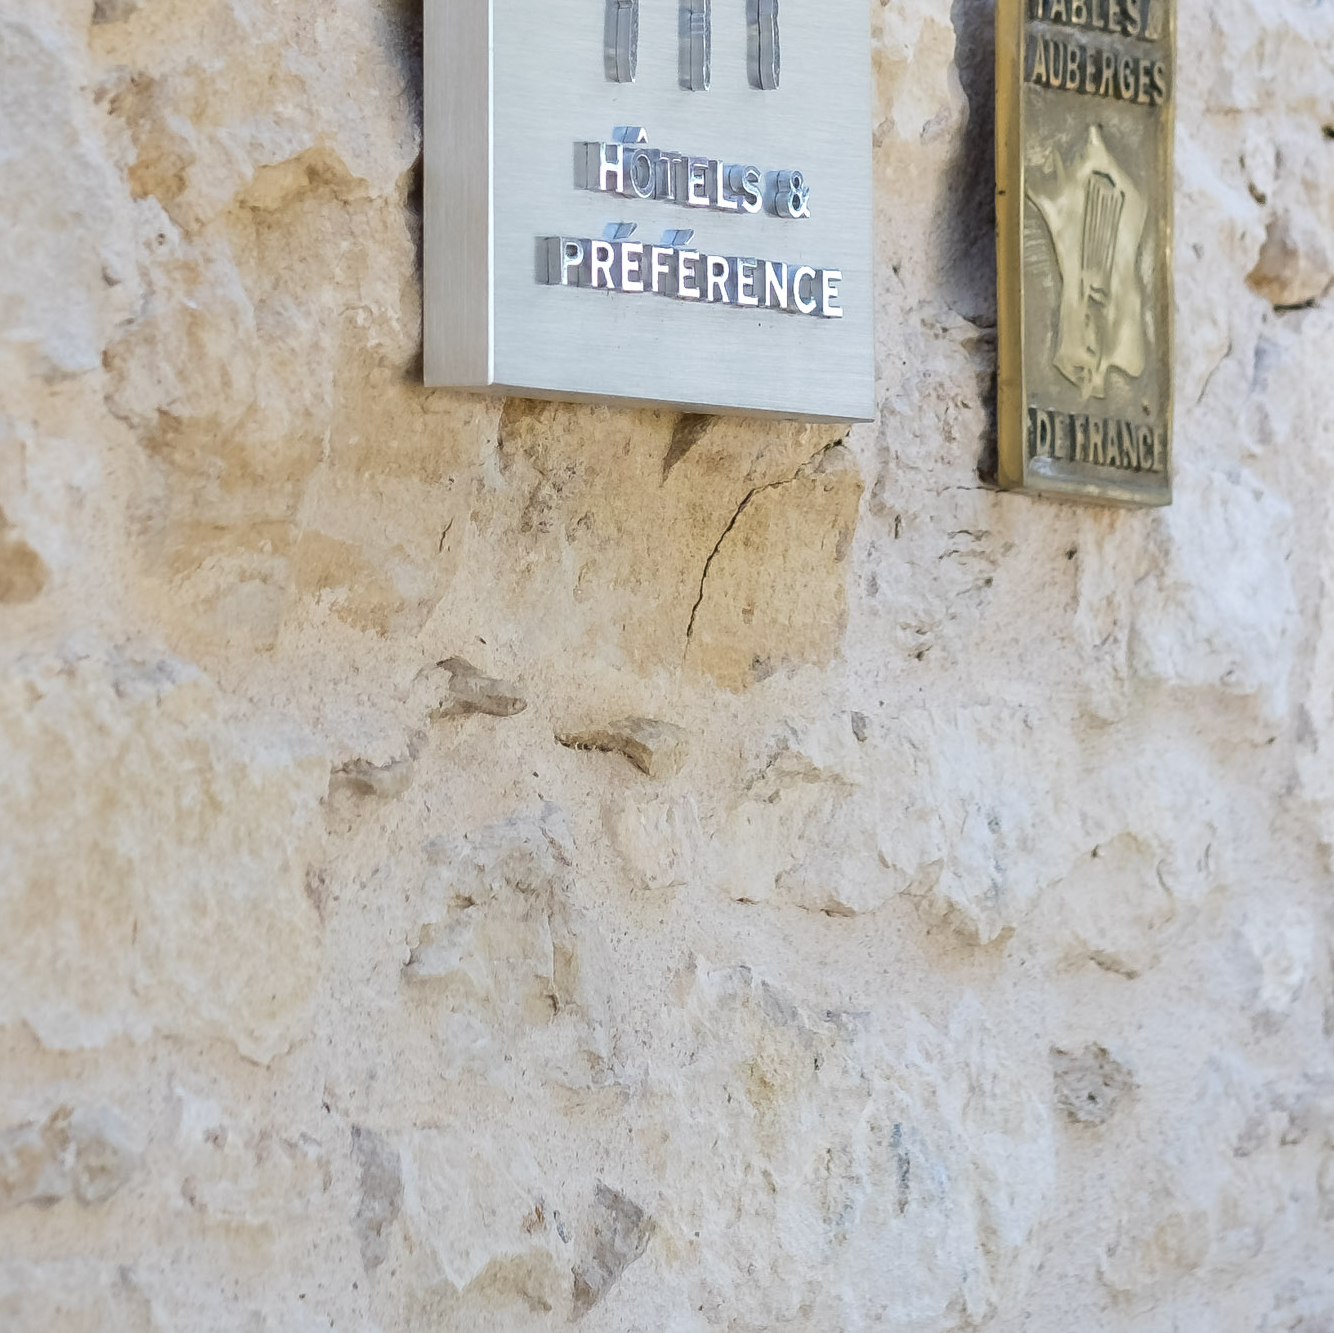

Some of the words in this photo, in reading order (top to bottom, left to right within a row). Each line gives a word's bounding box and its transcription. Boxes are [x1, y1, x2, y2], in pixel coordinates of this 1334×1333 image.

[1032, 33, 1165, 105] AUBERGES
[589, 126, 763, 215] HÔTELS
[774, 169, 811, 218] &
[552, 222, 844, 318] PRÉFÉRENCE
[1035, 408, 1067, 458] DE
[1076, 412, 1164, 470] FRANCE
